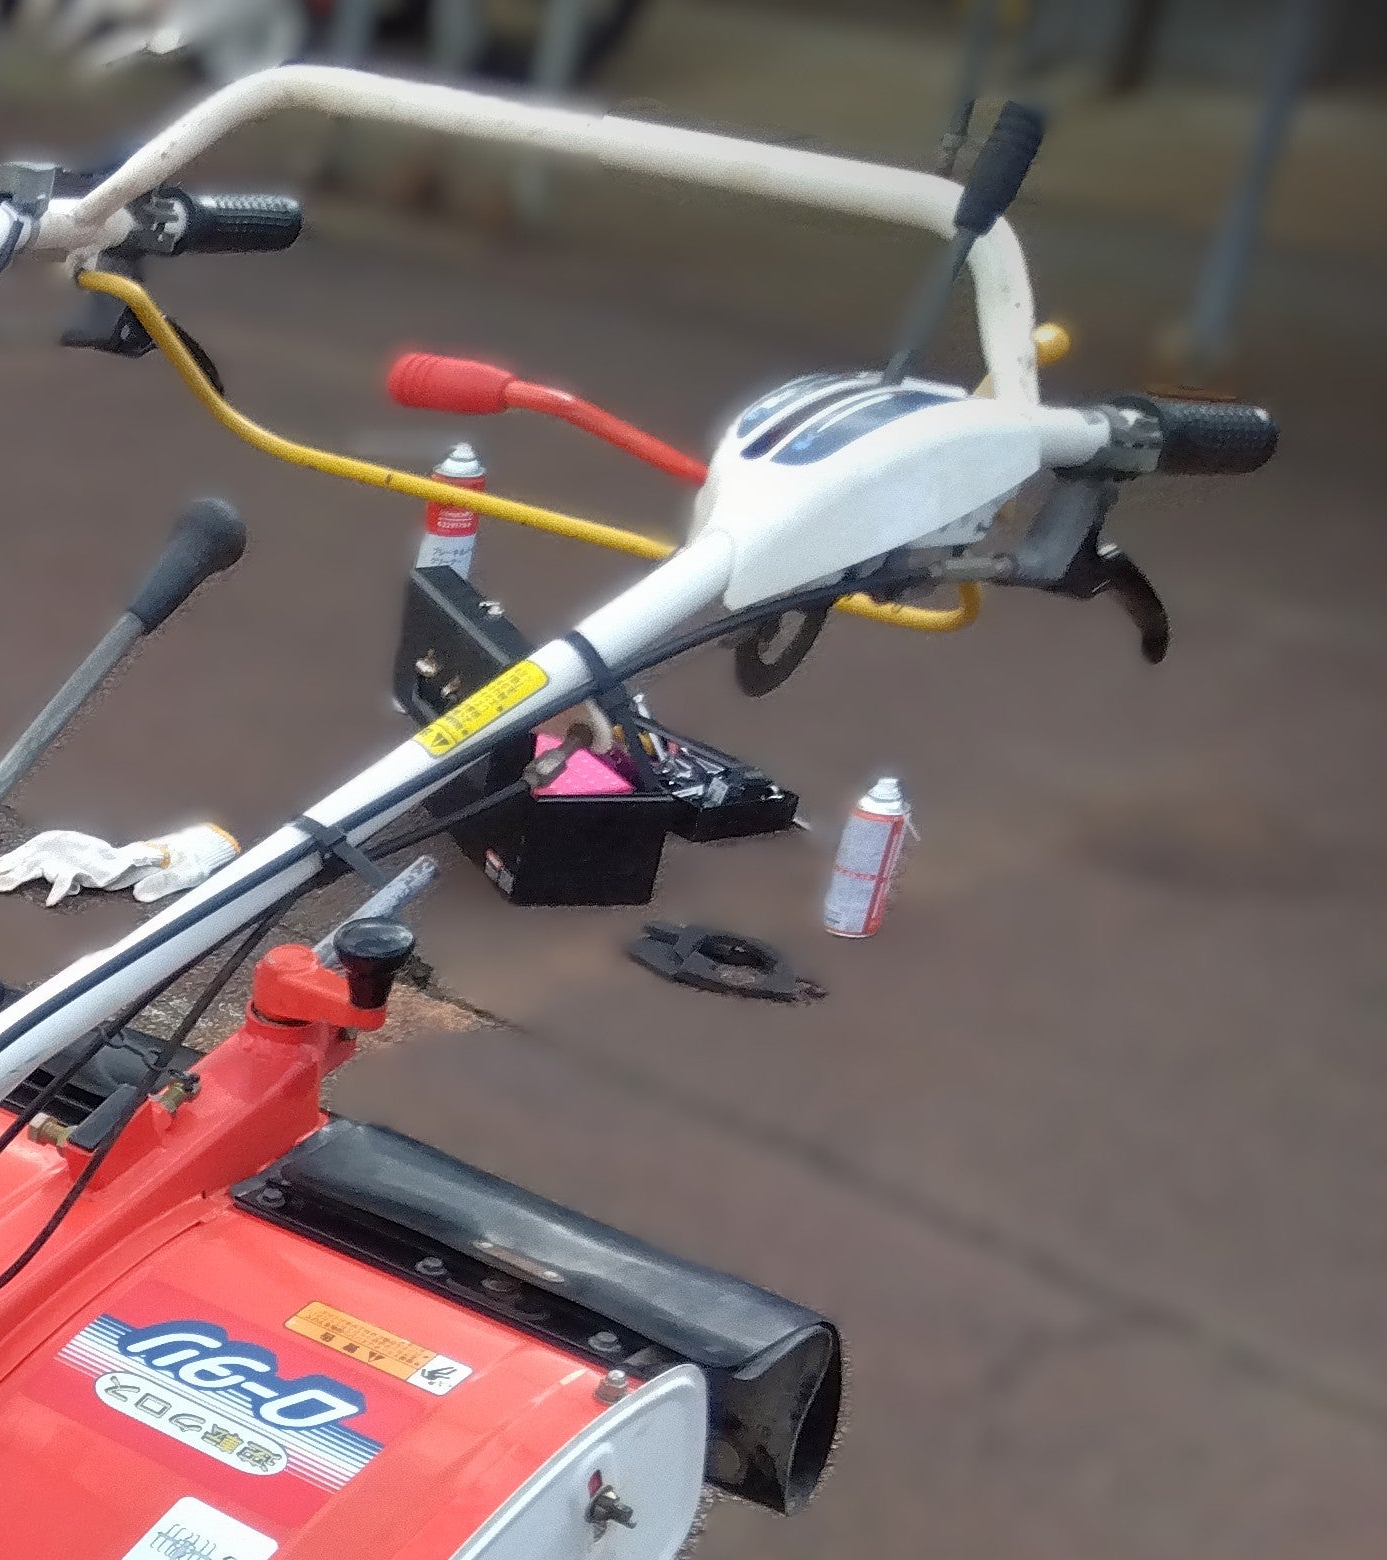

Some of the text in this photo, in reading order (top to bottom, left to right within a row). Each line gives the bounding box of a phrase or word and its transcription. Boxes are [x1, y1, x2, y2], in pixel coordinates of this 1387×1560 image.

[103, 1375, 282, 1473] 逆転クロス
[124, 1331, 362, 1430] ロータリ
